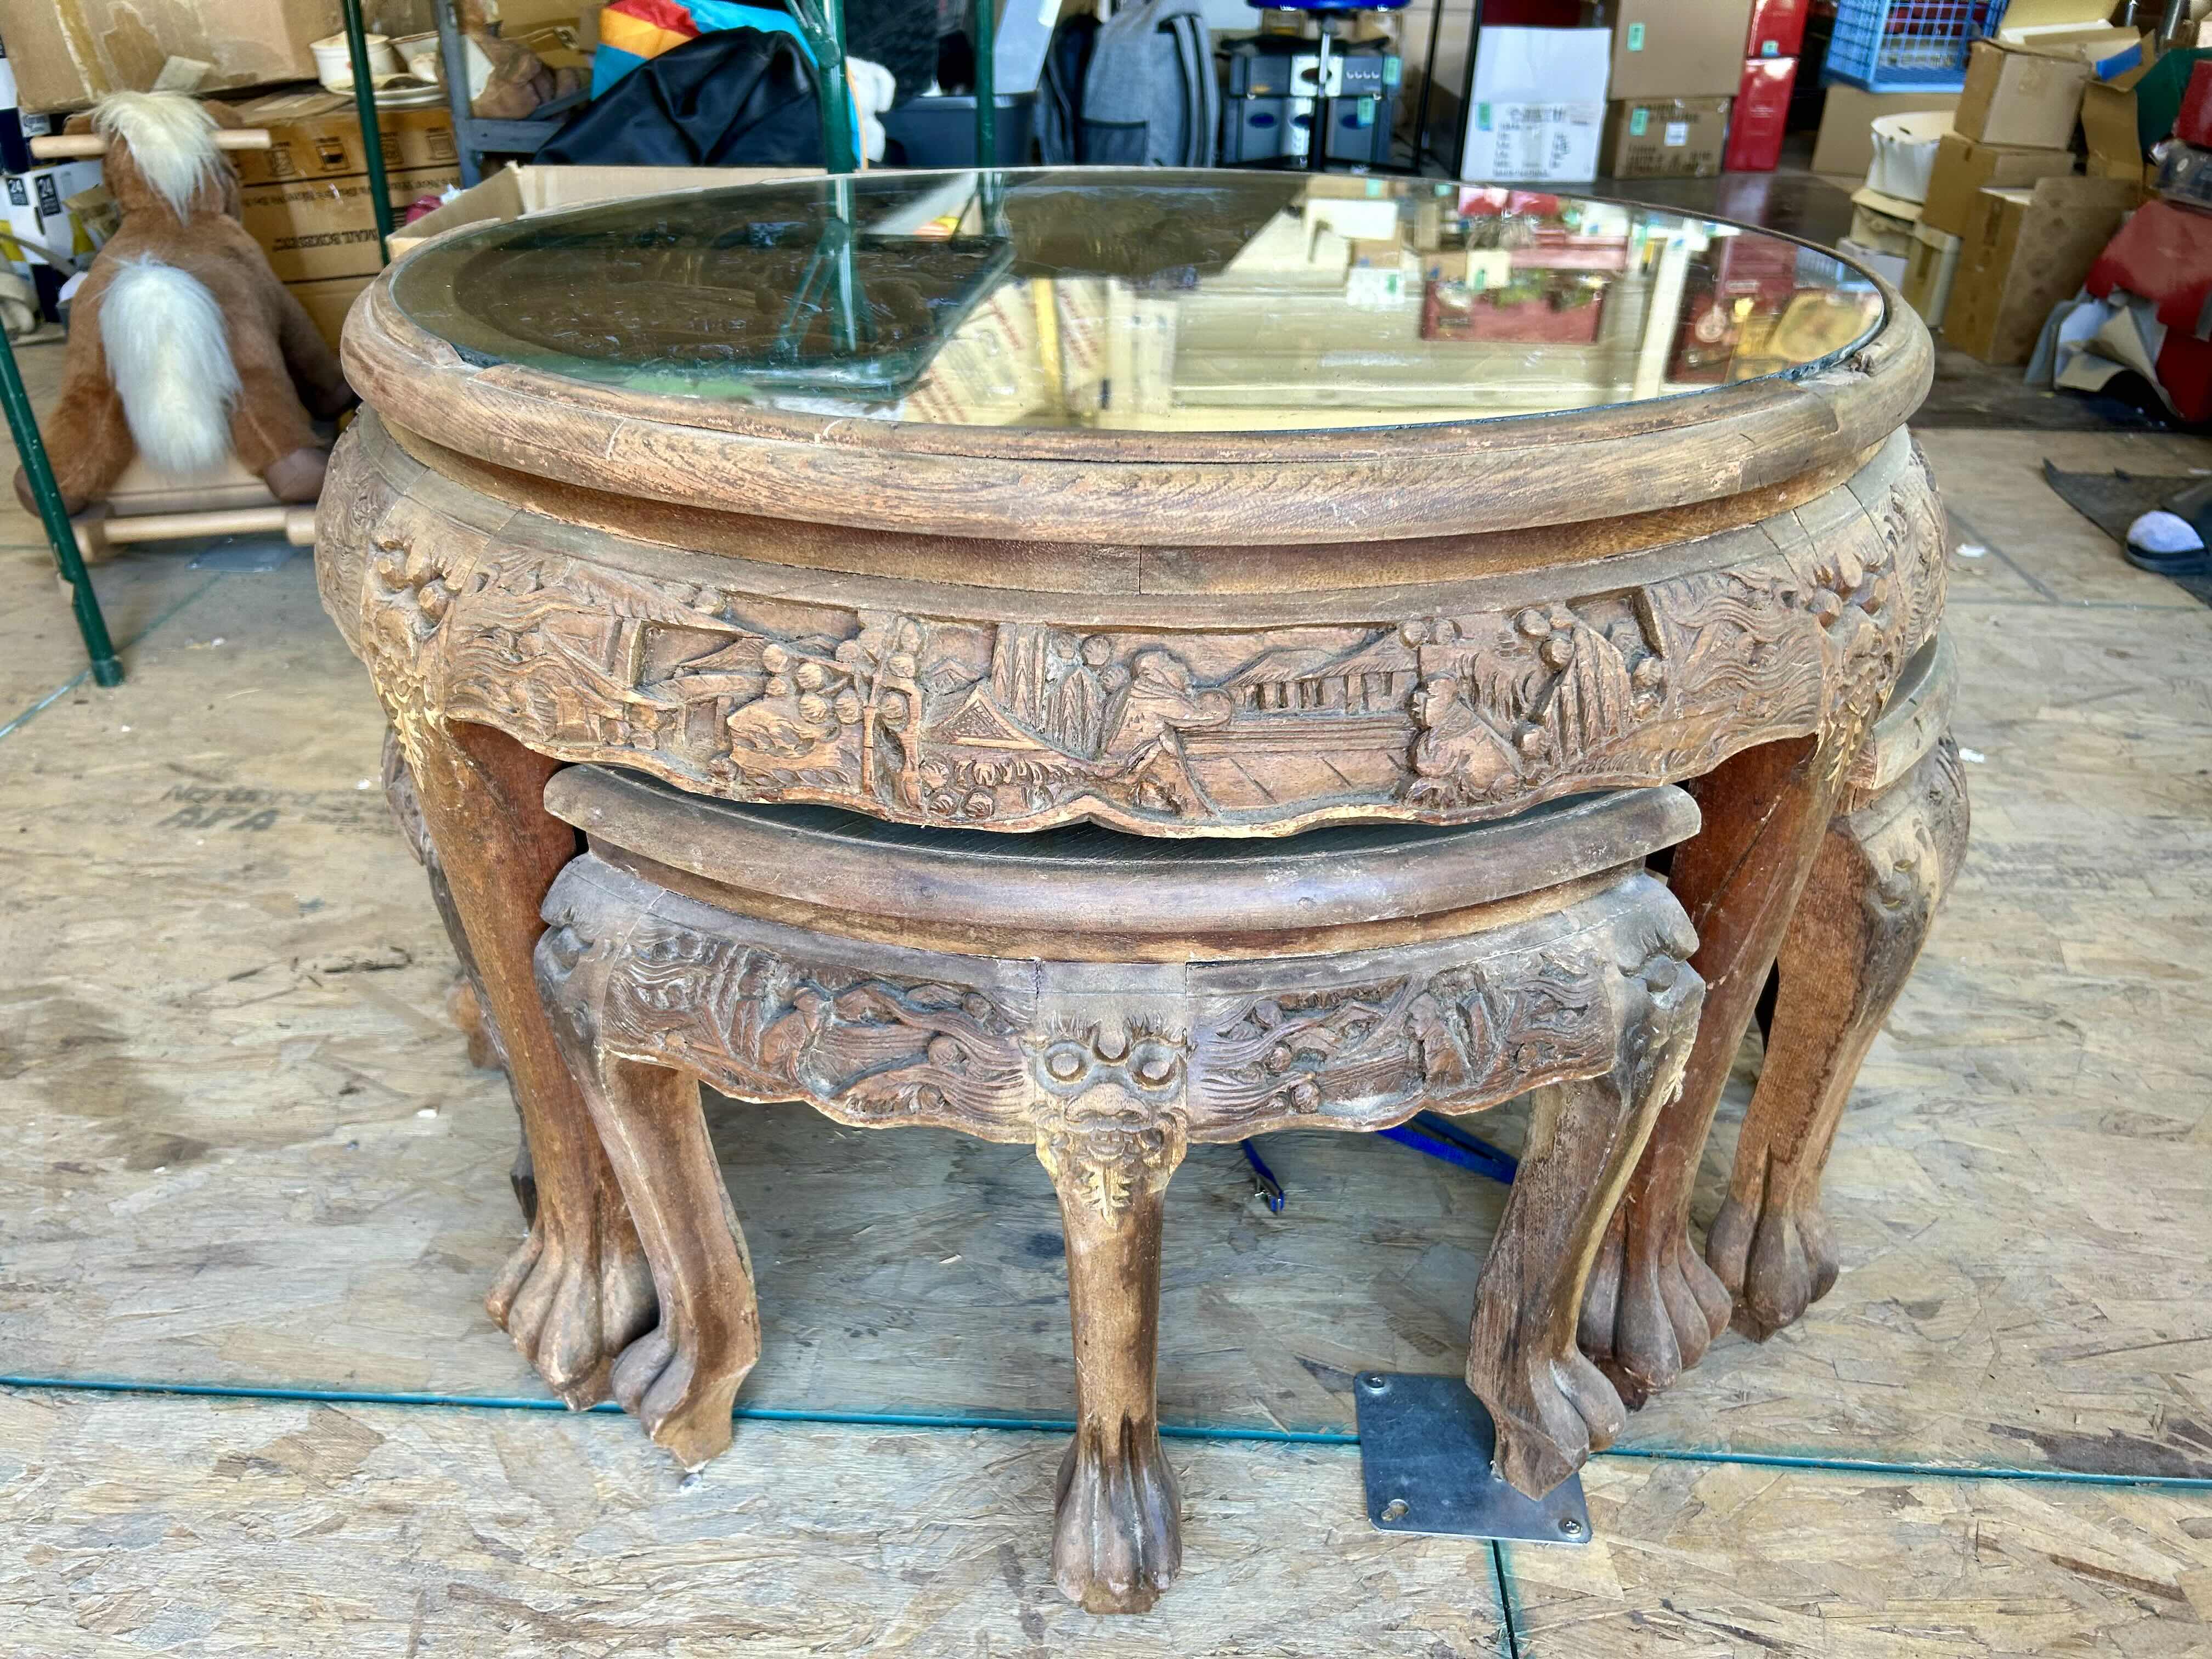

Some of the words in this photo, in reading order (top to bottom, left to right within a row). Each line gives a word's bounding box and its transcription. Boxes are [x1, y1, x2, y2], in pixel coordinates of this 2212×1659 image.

[8, 179, 22, 193] 24
[37, 178, 53, 198] 24
[342, 228, 378, 245] MAIL
